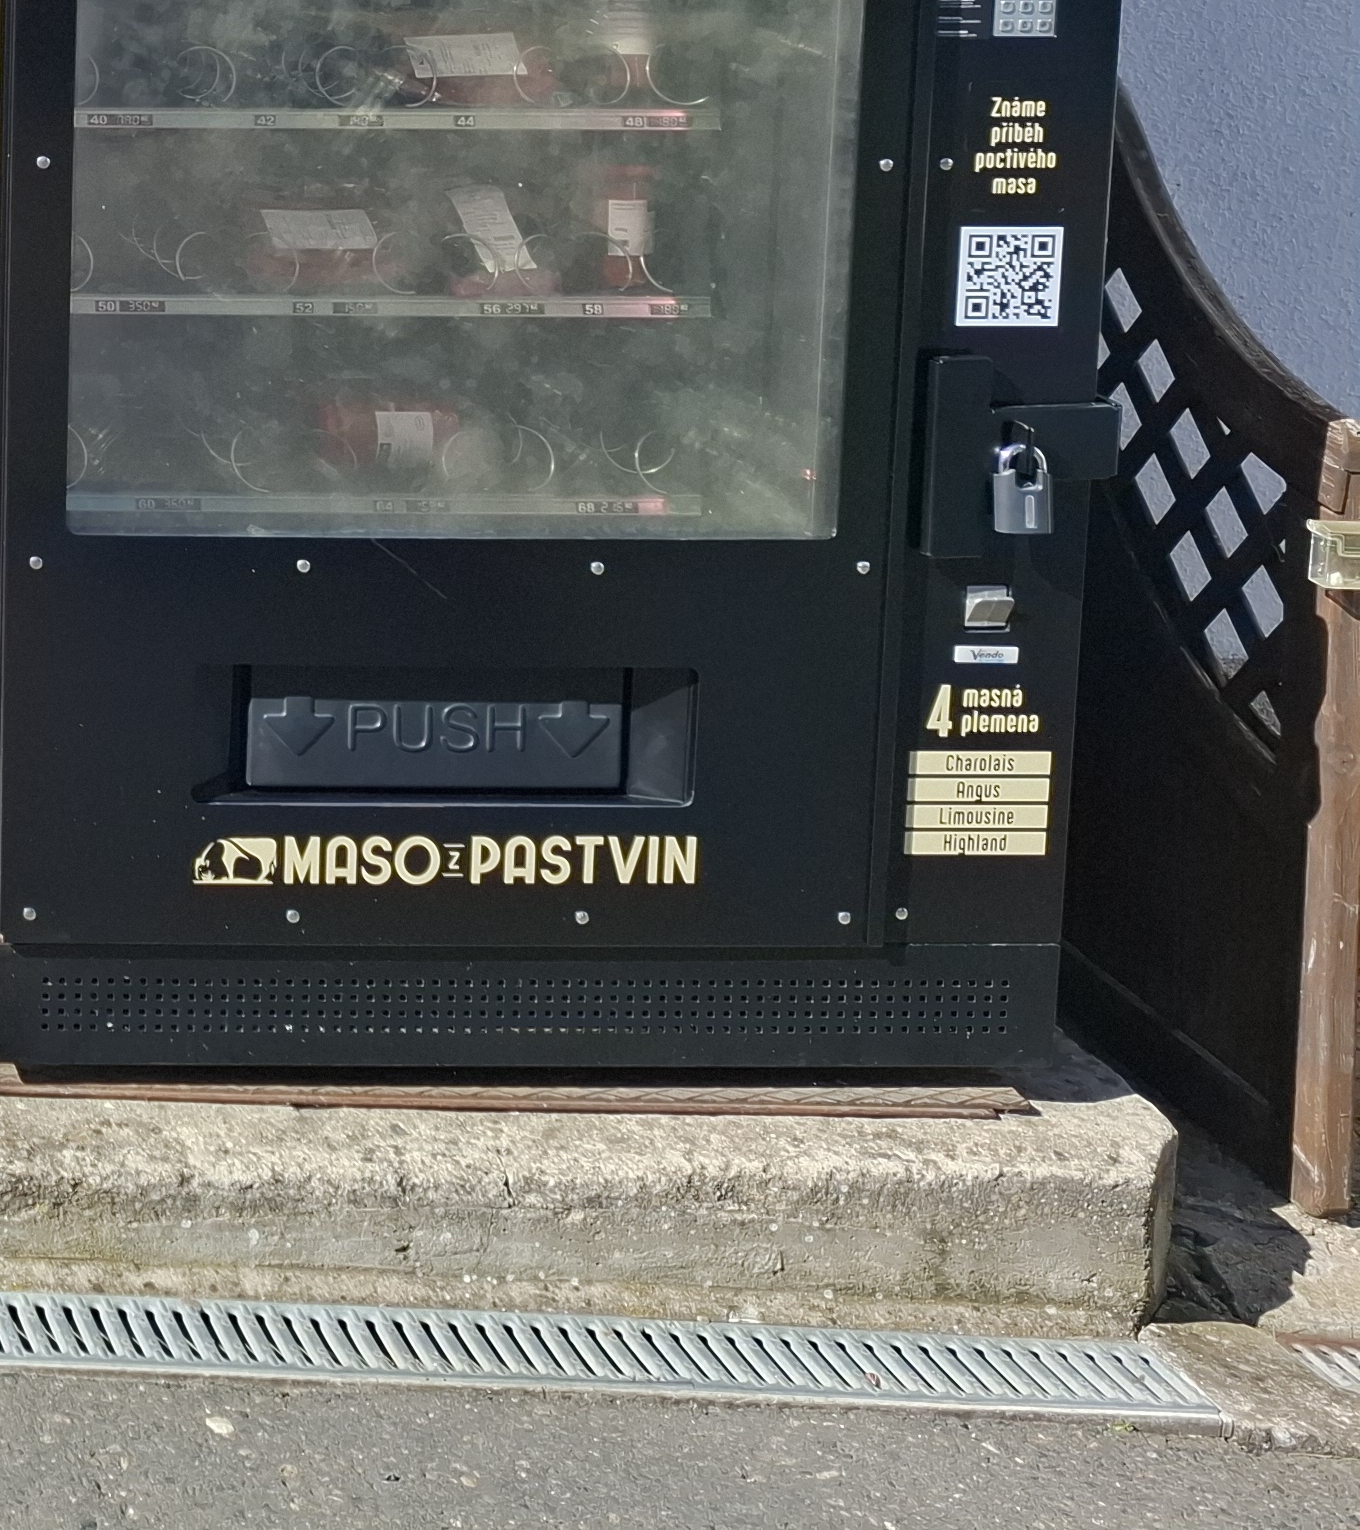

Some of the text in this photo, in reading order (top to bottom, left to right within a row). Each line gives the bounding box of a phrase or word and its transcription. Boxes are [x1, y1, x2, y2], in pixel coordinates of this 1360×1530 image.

[990, 96, 1046, 118] Známe
[89, 116, 108, 125] 40
[257, 116, 275, 126] 42
[457, 116, 475, 126] 44
[625, 117, 643, 127] 48
[990, 122, 1044, 147] příběh
[974, 148, 1057, 173] poctivého
[991, 177, 1037, 195] masa
[98, 300, 151, 311] 50 350
[295, 303, 313, 312] 52
[483, 304, 501, 314] 56
[584, 304, 602, 314] 58
[138, 499, 156, 509] 60
[578, 503, 595, 513] 68
[970, 648, 1004, 661] Vendo
[926, 684, 1023, 738] 4 masná
[348, 703, 527, 753] PUSH
[960, 710, 1039, 737] plemena
[945, 754, 1016, 772] Charolais
[956, 781, 1001, 802] Angus
[939, 807, 1015, 825] Limousine
[943, 834, 1008, 855] Highland
[283, 835, 441, 886] MASO
[471, 835, 698, 886] PASTVIN
